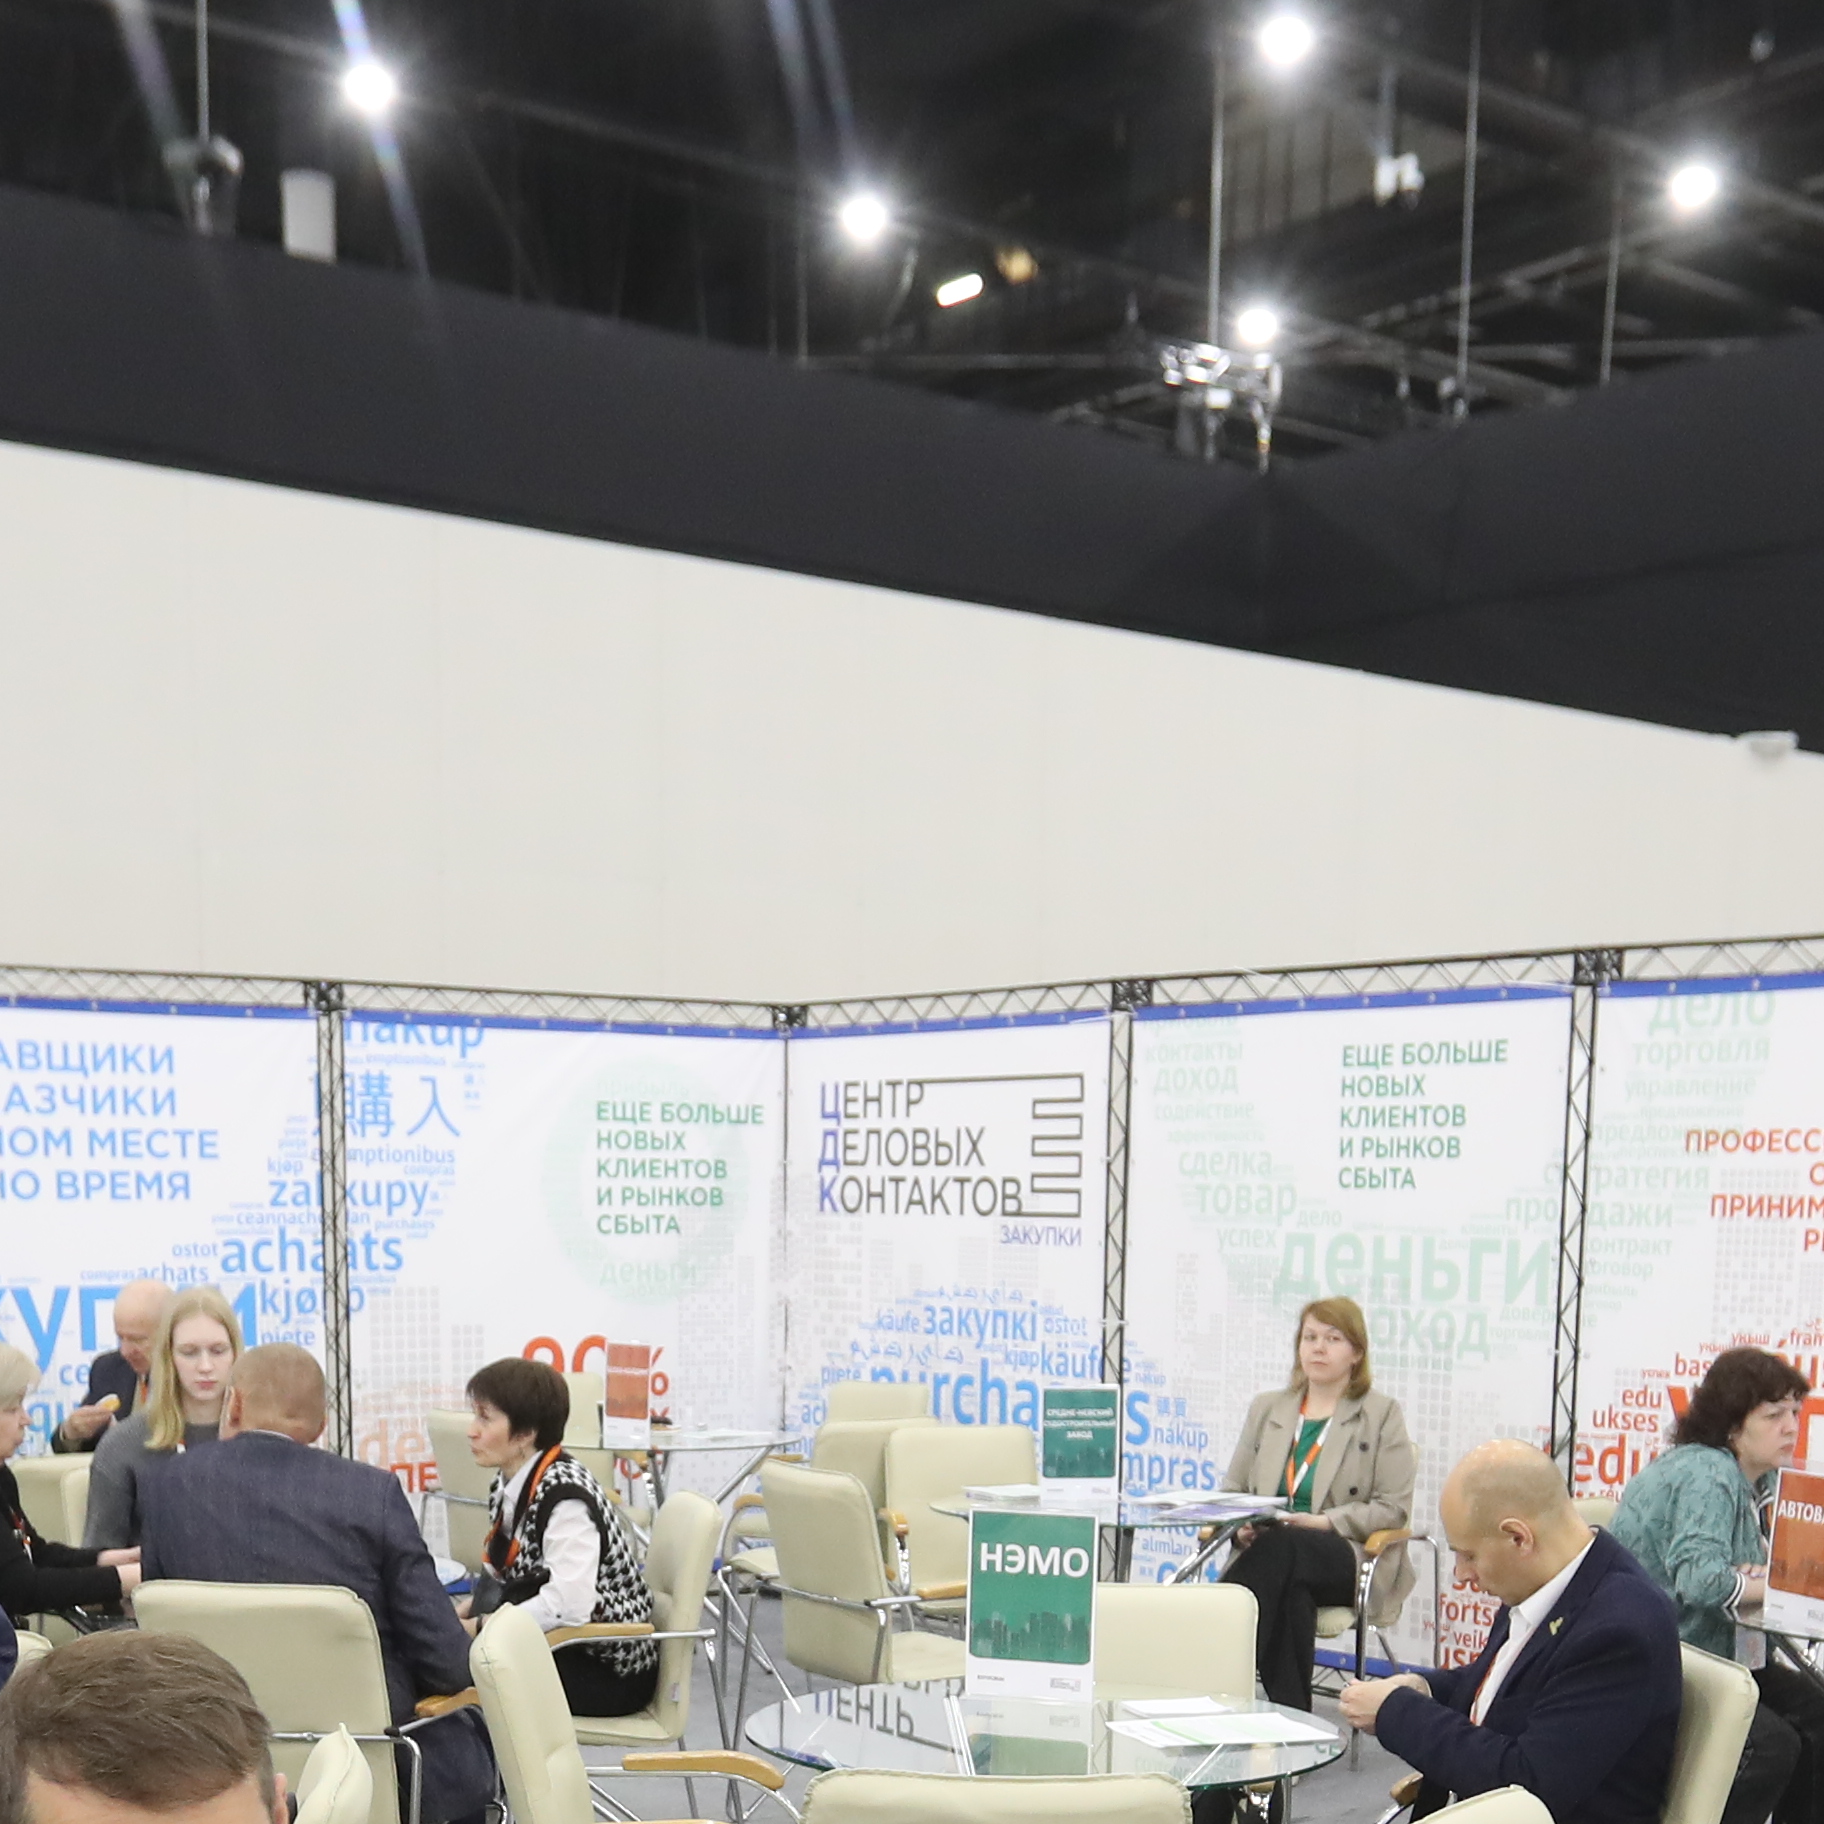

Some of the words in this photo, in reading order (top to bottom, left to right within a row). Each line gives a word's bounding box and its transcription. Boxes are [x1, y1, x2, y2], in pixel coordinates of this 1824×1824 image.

[1342, 1046, 1393, 1070] ЕЩЕ
[1401, 1039, 1508, 1066] БОЛЬШЕ
[1633, 1036, 1771, 1069] торговля
[1153, 1064, 1240, 1096] доход
[1341, 1073, 1426, 1098] НОВЫХ
[1624, 1075, 1757, 1103] управление
[596, 1102, 653, 1126] ЕЩЕ
[660, 1102, 764, 1125] БОЛЬШЕ
[819, 1079, 925, 1127] ЦЕНТР
[1339, 1104, 1467, 1129] КЛИЕНТОВ
[88, 1128, 219, 1160] МЕСТЕ
[596, 1130, 687, 1151] НОВЫХ
[817, 1126, 987, 1173] ДЕЛОВЫХ
[1339, 1136, 1353, 1158] И
[1360, 1135, 1462, 1158] РЫНКОВ
[596, 1158, 728, 1180] КЛИЕНТОВ
[1178, 1149, 1274, 1180] сделка
[1338, 1166, 1417, 1190] СБЫТА
[55, 1170, 191, 1201] ВРЕМЯ
[596, 1186, 613, 1206] И
[619, 1186, 724, 1207] РЫНКОВ
[818, 1176, 1024, 1217] КОНТАКТОВ
[1194, 1183, 1299, 1228] товар
[1296, 1208, 1344, 1230] дело
[596, 1214, 681, 1235] СБЫТА
[999, 1225, 1083, 1248] ЗАКУПКИ
[171, 1240, 219, 1260] ostot
[1216, 1225, 1277, 1255] успех
[136, 1261, 209, 1284] achats
[1271, 1231, 1551, 1306] деньги
[1366, 1308, 1493, 1358] оход
[1621, 1387, 1663, 1409] edu
[1591, 1404, 1660, 1433] ukses
[1153, 1423, 1210, 1453] nakup
[1121, 1446, 1217, 1491] mpras
[979, 1542, 1090, 1578] НЭМО
